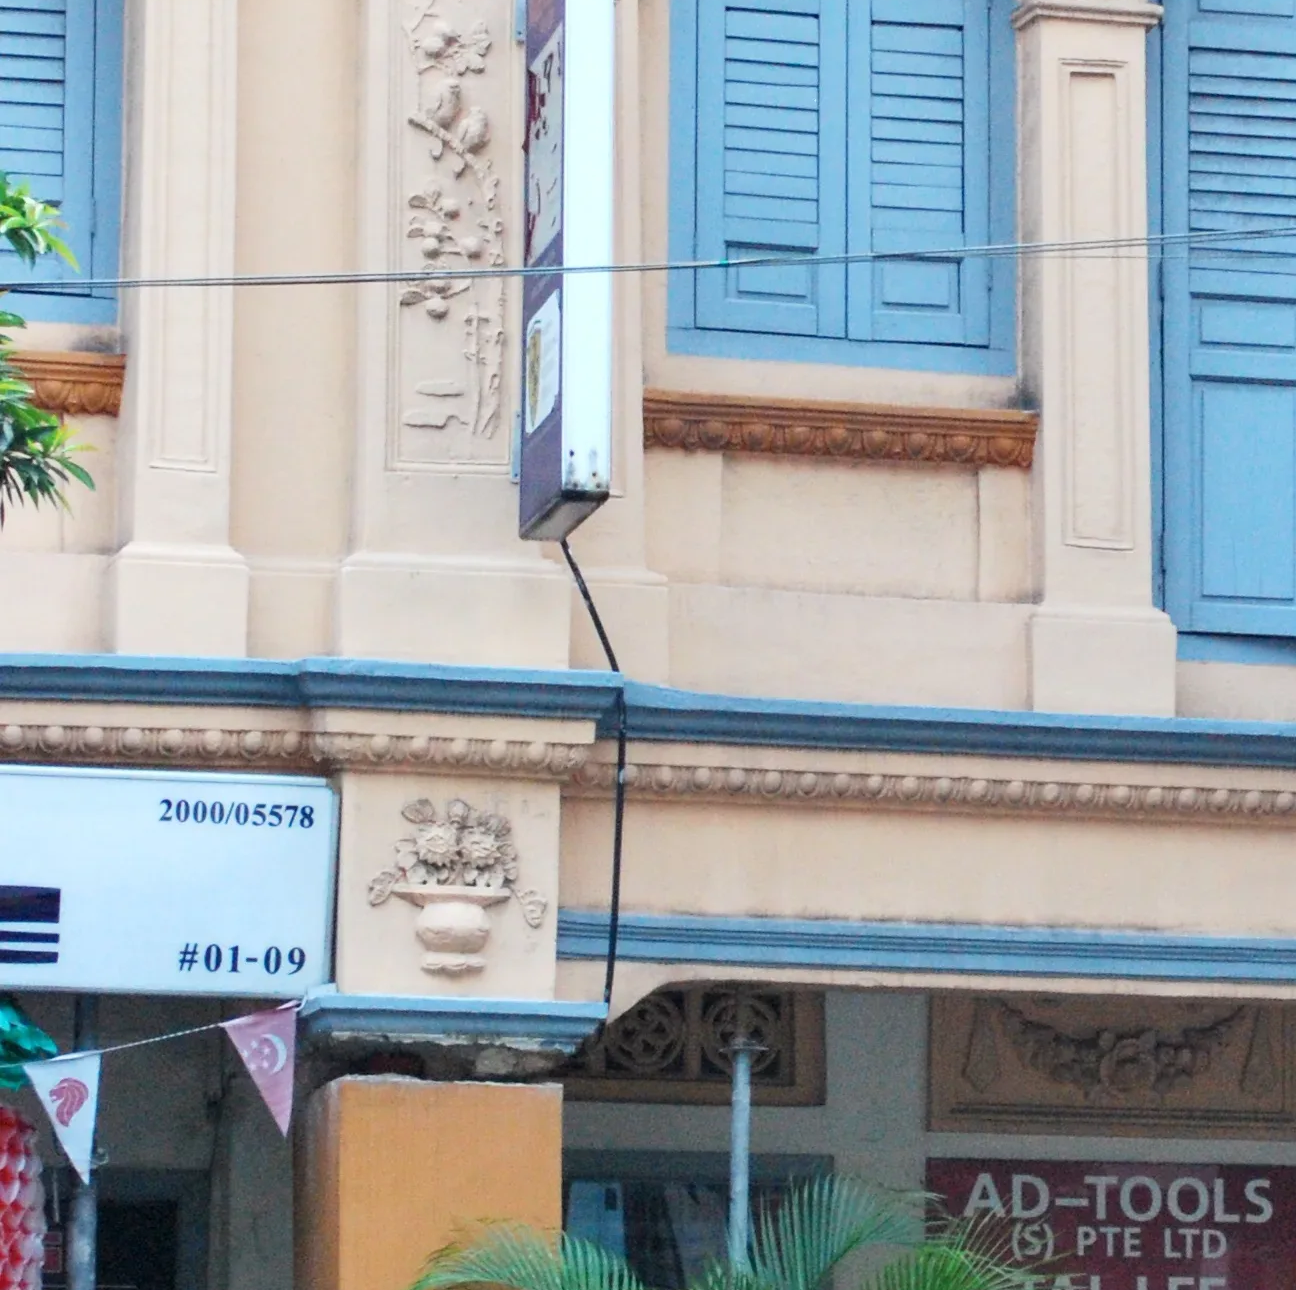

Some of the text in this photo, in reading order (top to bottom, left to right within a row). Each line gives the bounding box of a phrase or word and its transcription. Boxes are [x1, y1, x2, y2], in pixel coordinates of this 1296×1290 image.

[157, 797, 315, 829] 2000/05578
[177, 942, 307, 976] #01-09
[963, 1172, 1275, 1225] AD-TOOLS
[1012, 1222, 1229, 1261] (S) PTE LTD
